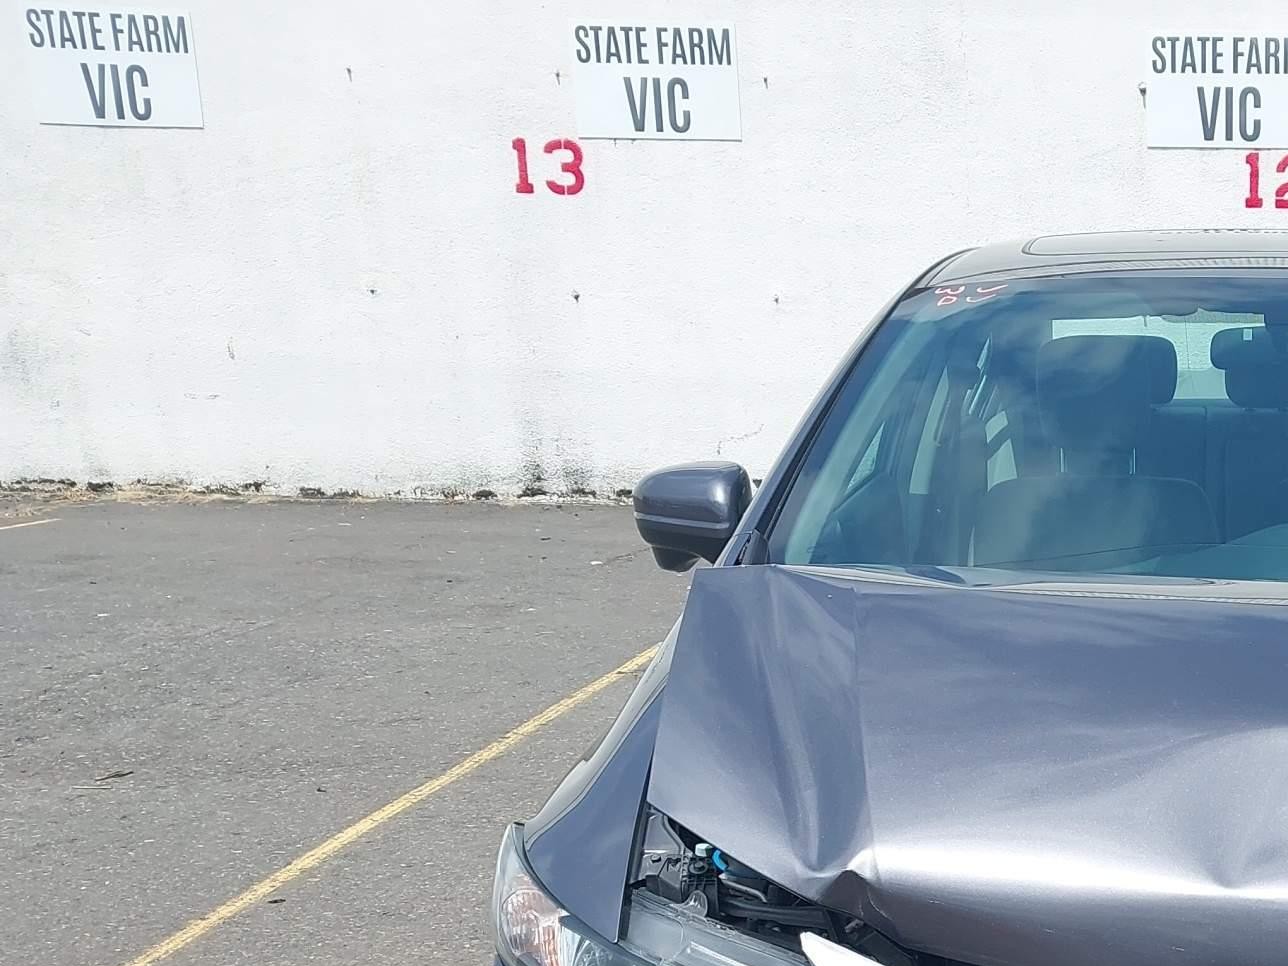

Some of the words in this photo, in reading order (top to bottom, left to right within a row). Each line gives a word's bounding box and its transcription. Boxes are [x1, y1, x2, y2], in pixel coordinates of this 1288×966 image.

[26, 8, 106, 51] STATE
[110, 13, 189, 54] FARM
[574, 25, 650, 65] STATE
[656, 27, 732, 66] FARM
[1151, 36, 1224, 74] STATE
[80, 62, 153, 121] VIC
[623, 76, 692, 134] VIC
[1195, 86, 1263, 142] VIC
[512, 137, 586, 196] 13
